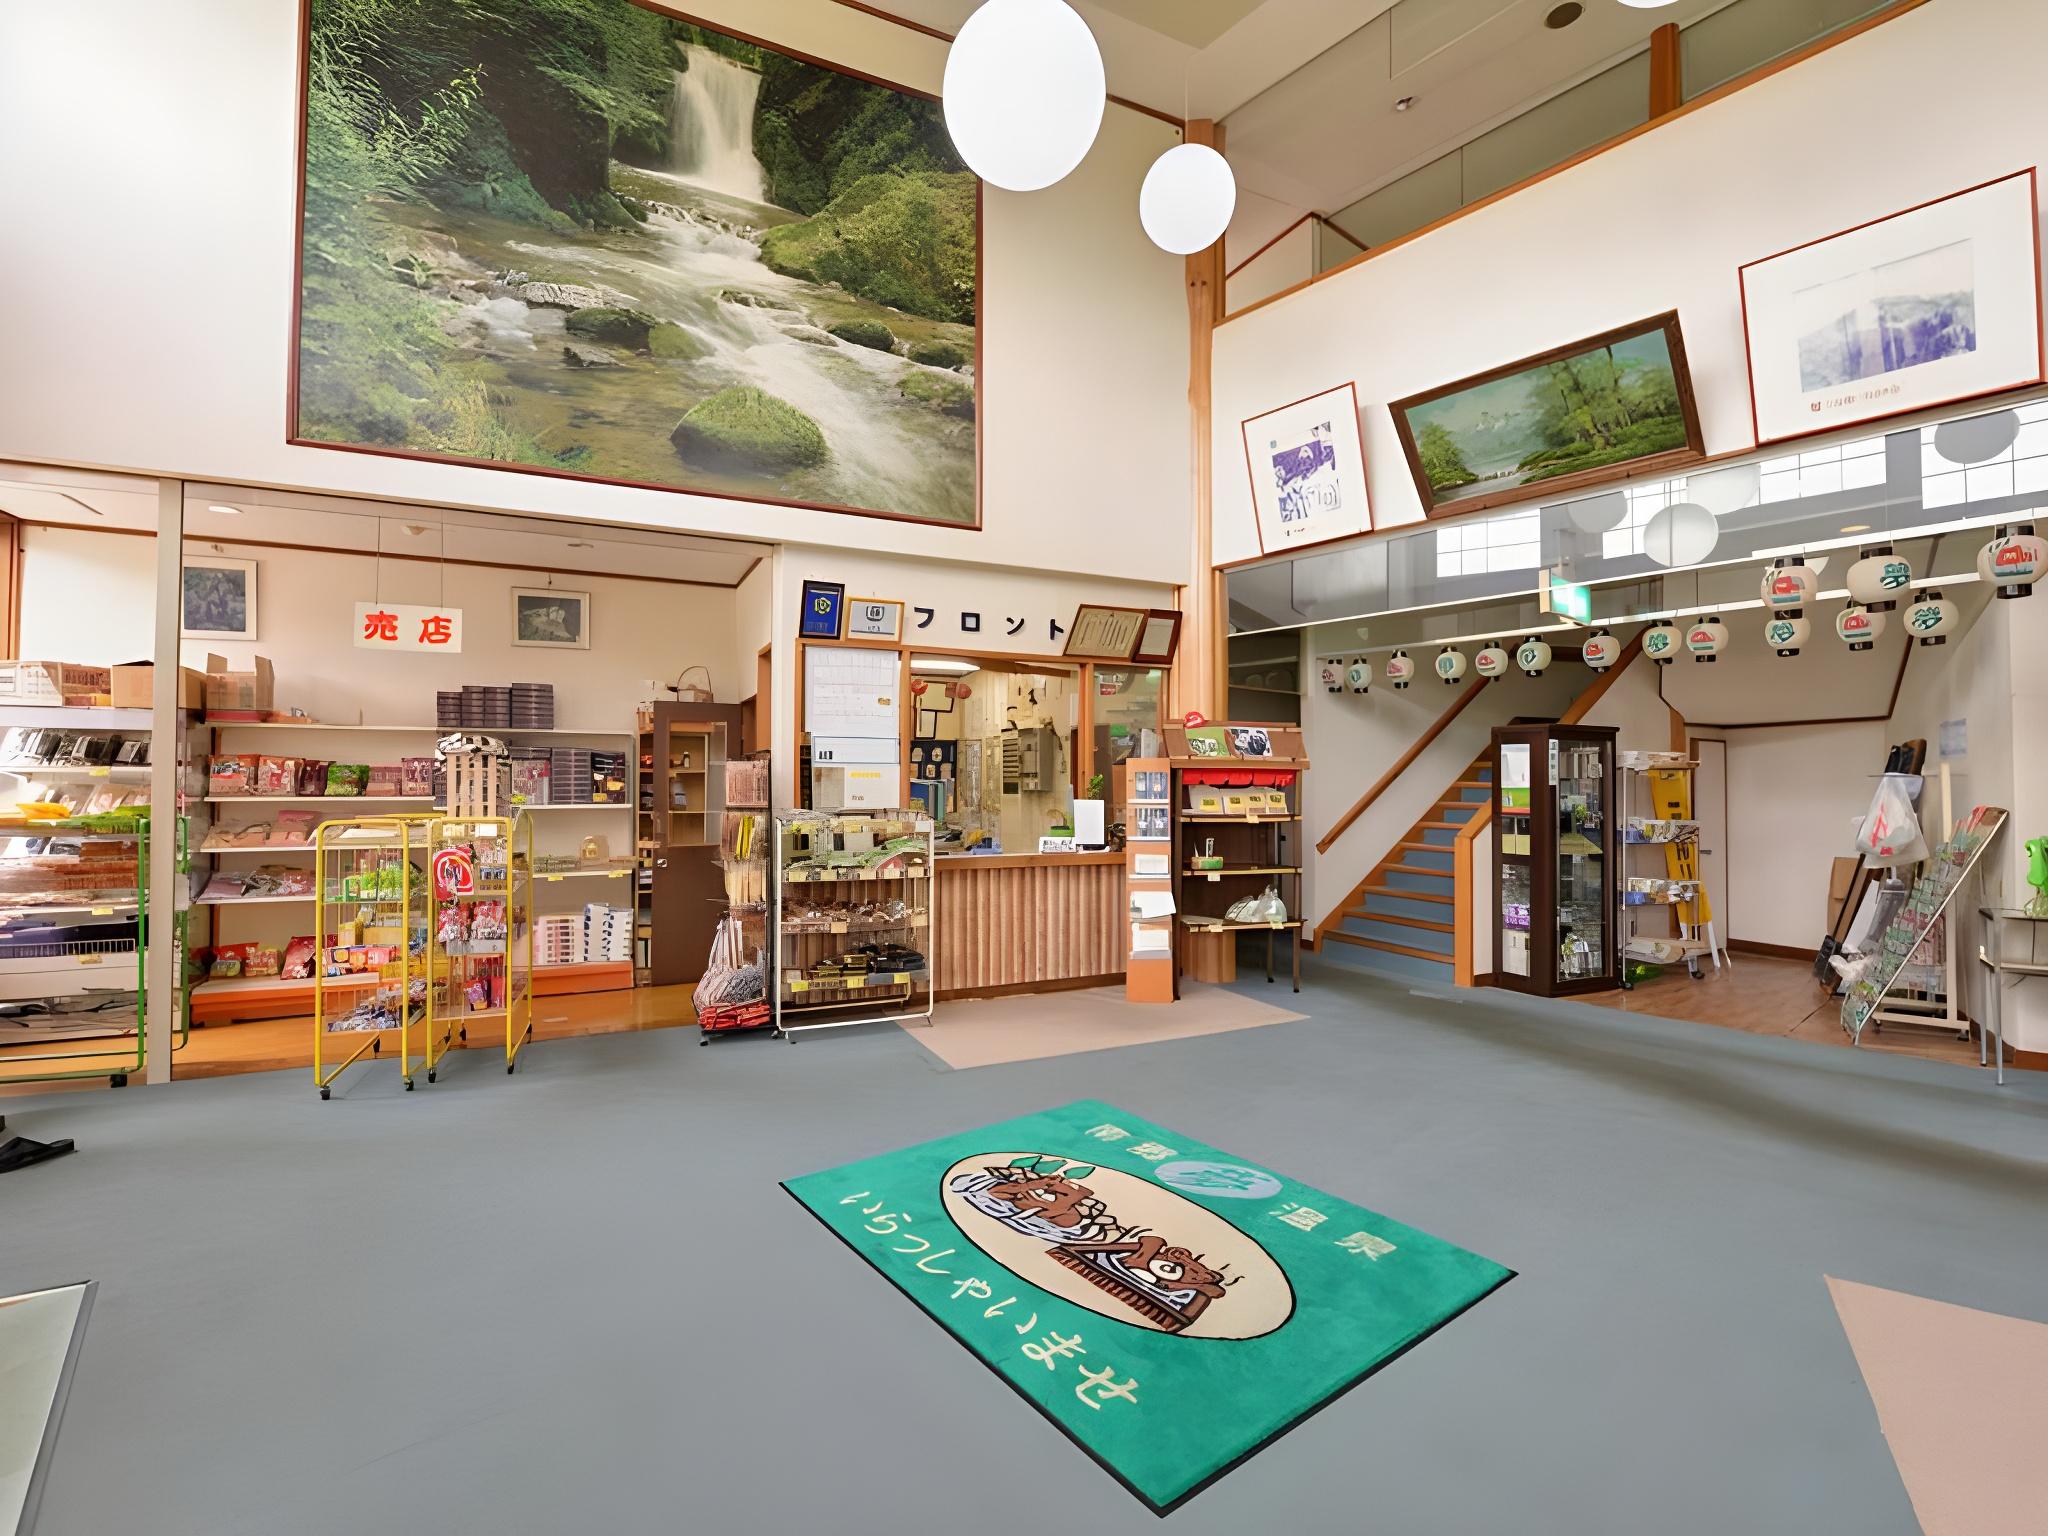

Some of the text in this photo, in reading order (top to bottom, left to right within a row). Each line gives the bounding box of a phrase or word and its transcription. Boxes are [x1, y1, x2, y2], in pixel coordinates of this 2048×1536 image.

[363, 610, 453, 644] 売店
[913, 606, 1065, 640] フロント
[839, 1191, 1139, 1411] いらっしゃいませ
